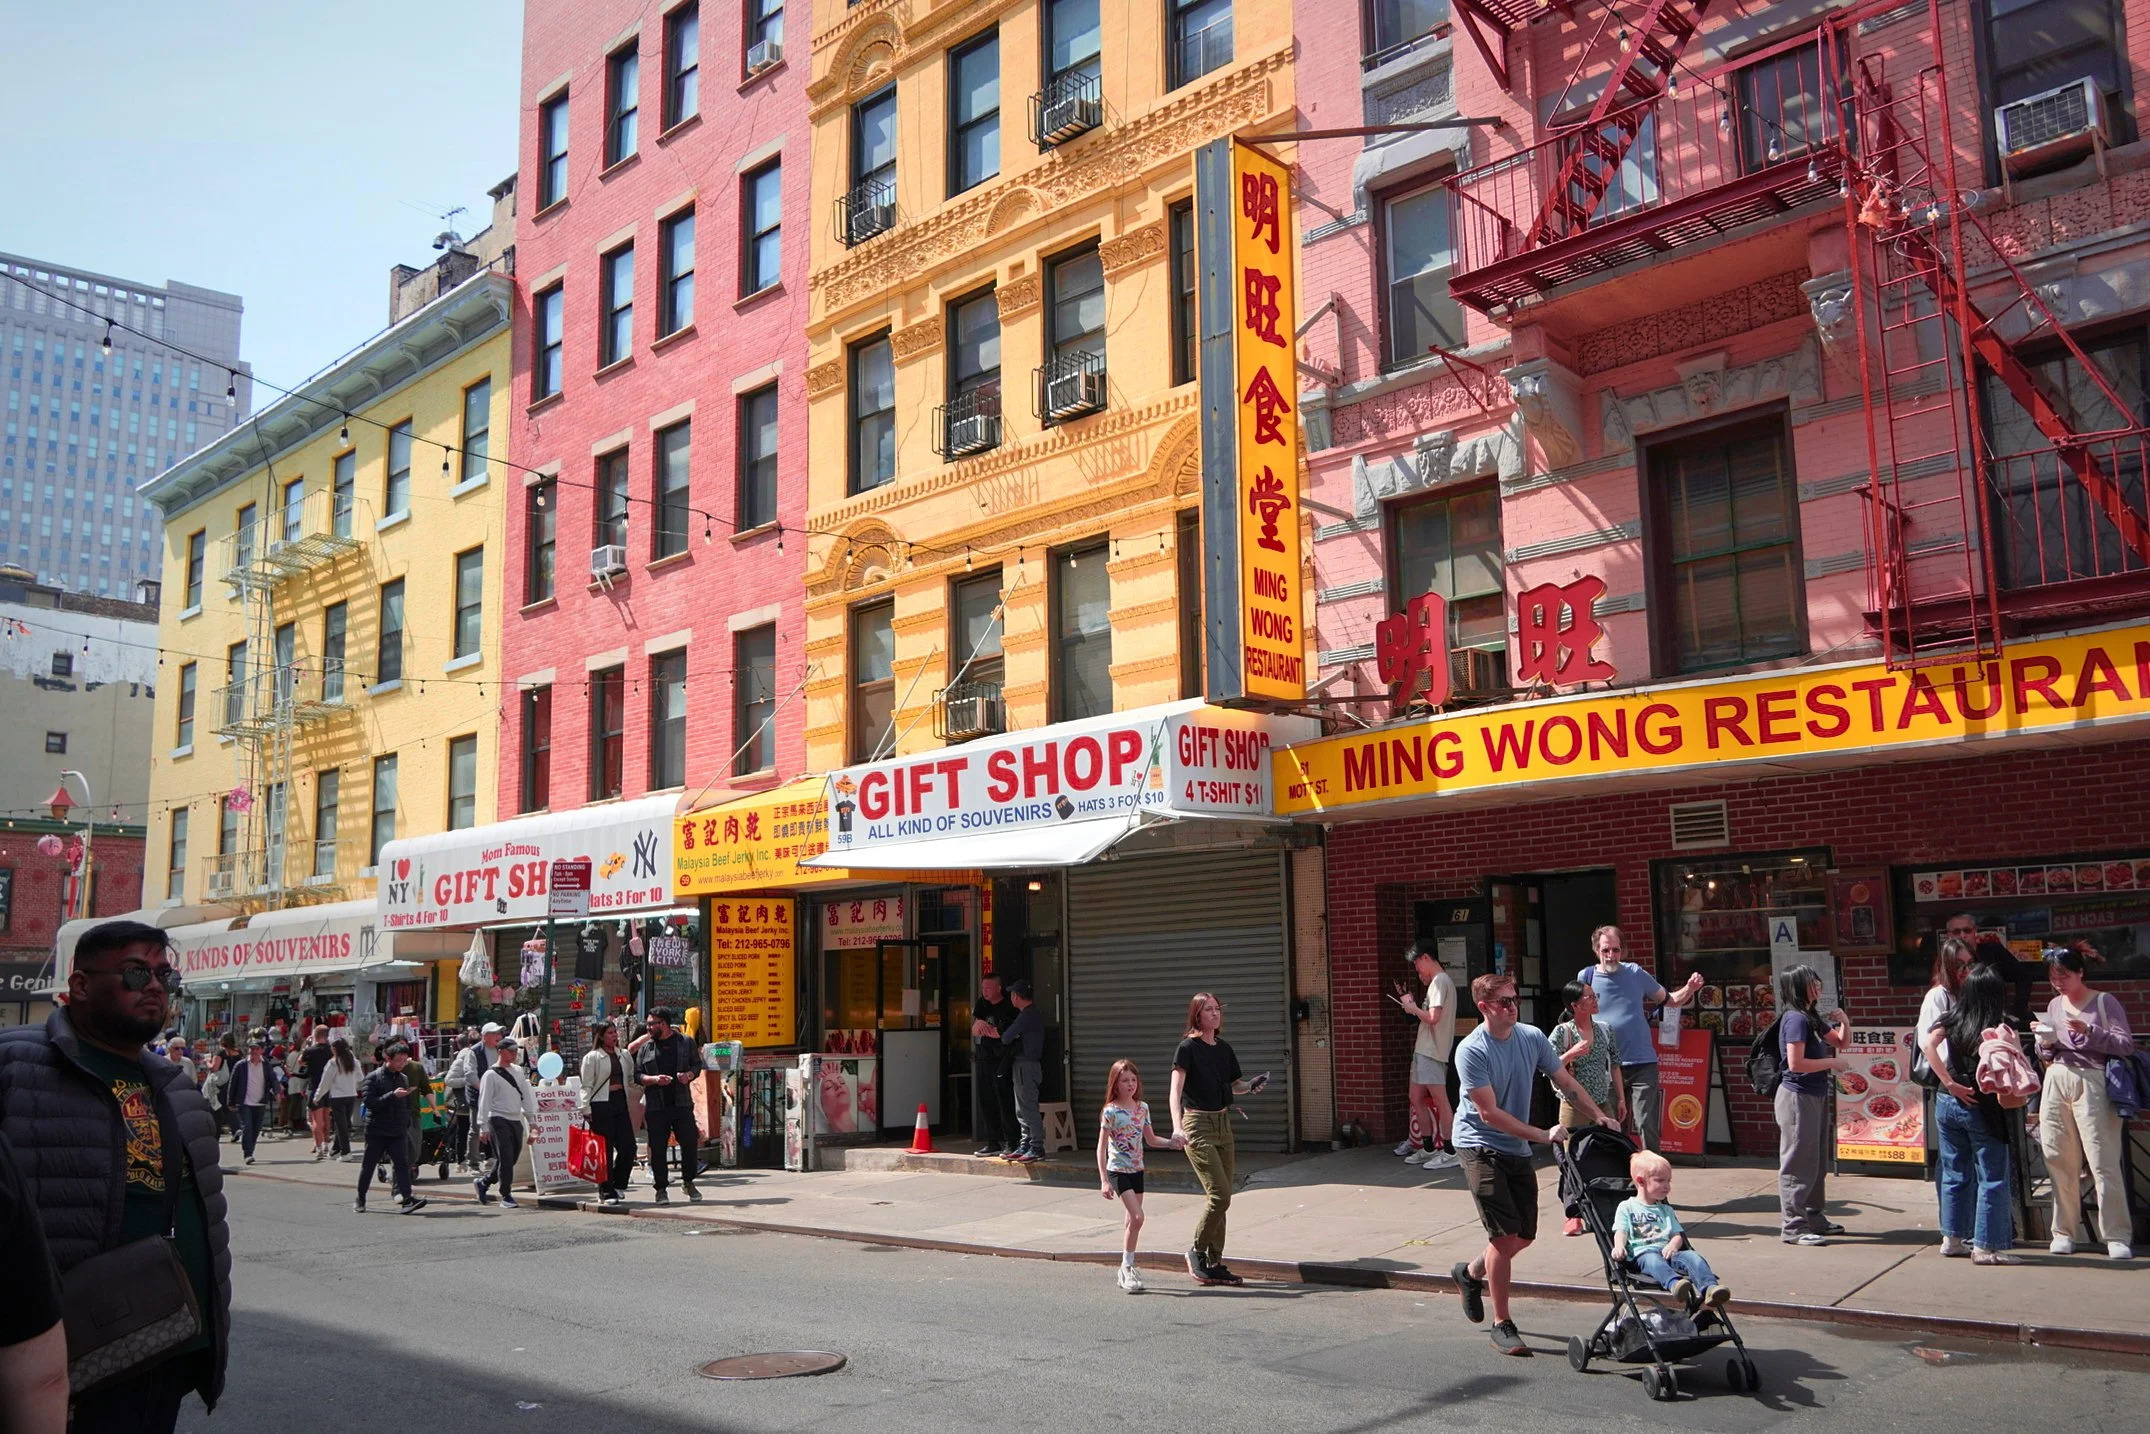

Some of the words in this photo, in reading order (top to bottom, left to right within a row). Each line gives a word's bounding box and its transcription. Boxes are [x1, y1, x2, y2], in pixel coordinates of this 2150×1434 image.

[1242, 170, 1291, 554] 明旺食堂
[1254, 566, 1287, 601] MING
[1251, 606, 1293, 644] WONG
[1376, 574, 1617, 708] 明旺
[1246, 645, 1301, 686] RESTAURANT
[1178, 725, 1219, 768] GIFT
[1343, 730, 1464, 792] MING
[1480, 703, 1682, 772] WONG
[858, 757, 968, 820] GIFT
[987, 729, 1143, 803] SHOP
[1186, 780, 1194, 798] 4
[1198, 781, 1241, 804] T-SHIT
[1245, 784, 1263, 805] $1
[1289, 780, 1314, 799] MOTT
[1315, 779, 1329, 794] ST.
[1078, 799, 1106, 813] HATS
[1108, 798, 1116, 810] 3
[1118, 794, 1141, 809] FOR
[1145, 791, 1164, 805] $10
[682, 812, 762, 850] 富記肉乾
[868, 825, 894, 840] ALL
[899, 820, 931, 836] KIND
[936, 817, 955, 832] OF
[961, 803, 1052, 828] SOUVENIRS
[837, 834, 852, 844] 59B
[481, 847, 502, 865] Mom
[505, 842, 541, 859] Famous
[678, 855, 710, 871] Malaysia
[712, 851, 730, 866] Beef
[732, 850, 754, 866] Jerky
[757, 848, 771, 861] Inc.
[390, 860, 396, 881] I
[388, 882, 410, 905] NY
[434, 866, 500, 907] GIFT
[615, 890, 624, 905] 3
[627, 889, 646, 905] For
[650, 887, 662, 902] 10
[383, 912, 415, 928] T-Shirts
[415, 911, 422, 923] 4
[423, 910, 437, 923] For
[439, 908, 448, 921] 10
[717, 904, 788, 924] 富記肉乾
[1454, 910, 1466, 920] 61
[716, 926, 744, 936] Malaysia
[745, 926, 759, 934] Beef
[761, 926, 777, 936] Jerky
[779, 926, 789, 935] Inc.
[838, 937, 851, 946] Tel:
[1775, 921, 1793, 942] A
[187, 946, 229, 972] KINDS
[233, 942, 251, 966] OF
[254, 933, 350, 964] SOUVENIRS
[716, 939, 733, 949] Tel:
[735, 939, 790, 949] 212-965-0796
[1850, 1032, 1896, 1045] 旺食堂
[548, 1135, 563, 1143] min
[583, 1139, 599, 1180] C21
[1888, 1151, 1905, 1159] $88
[542, 1174, 552, 1182] 30
[554, 1173, 569, 1181] min
